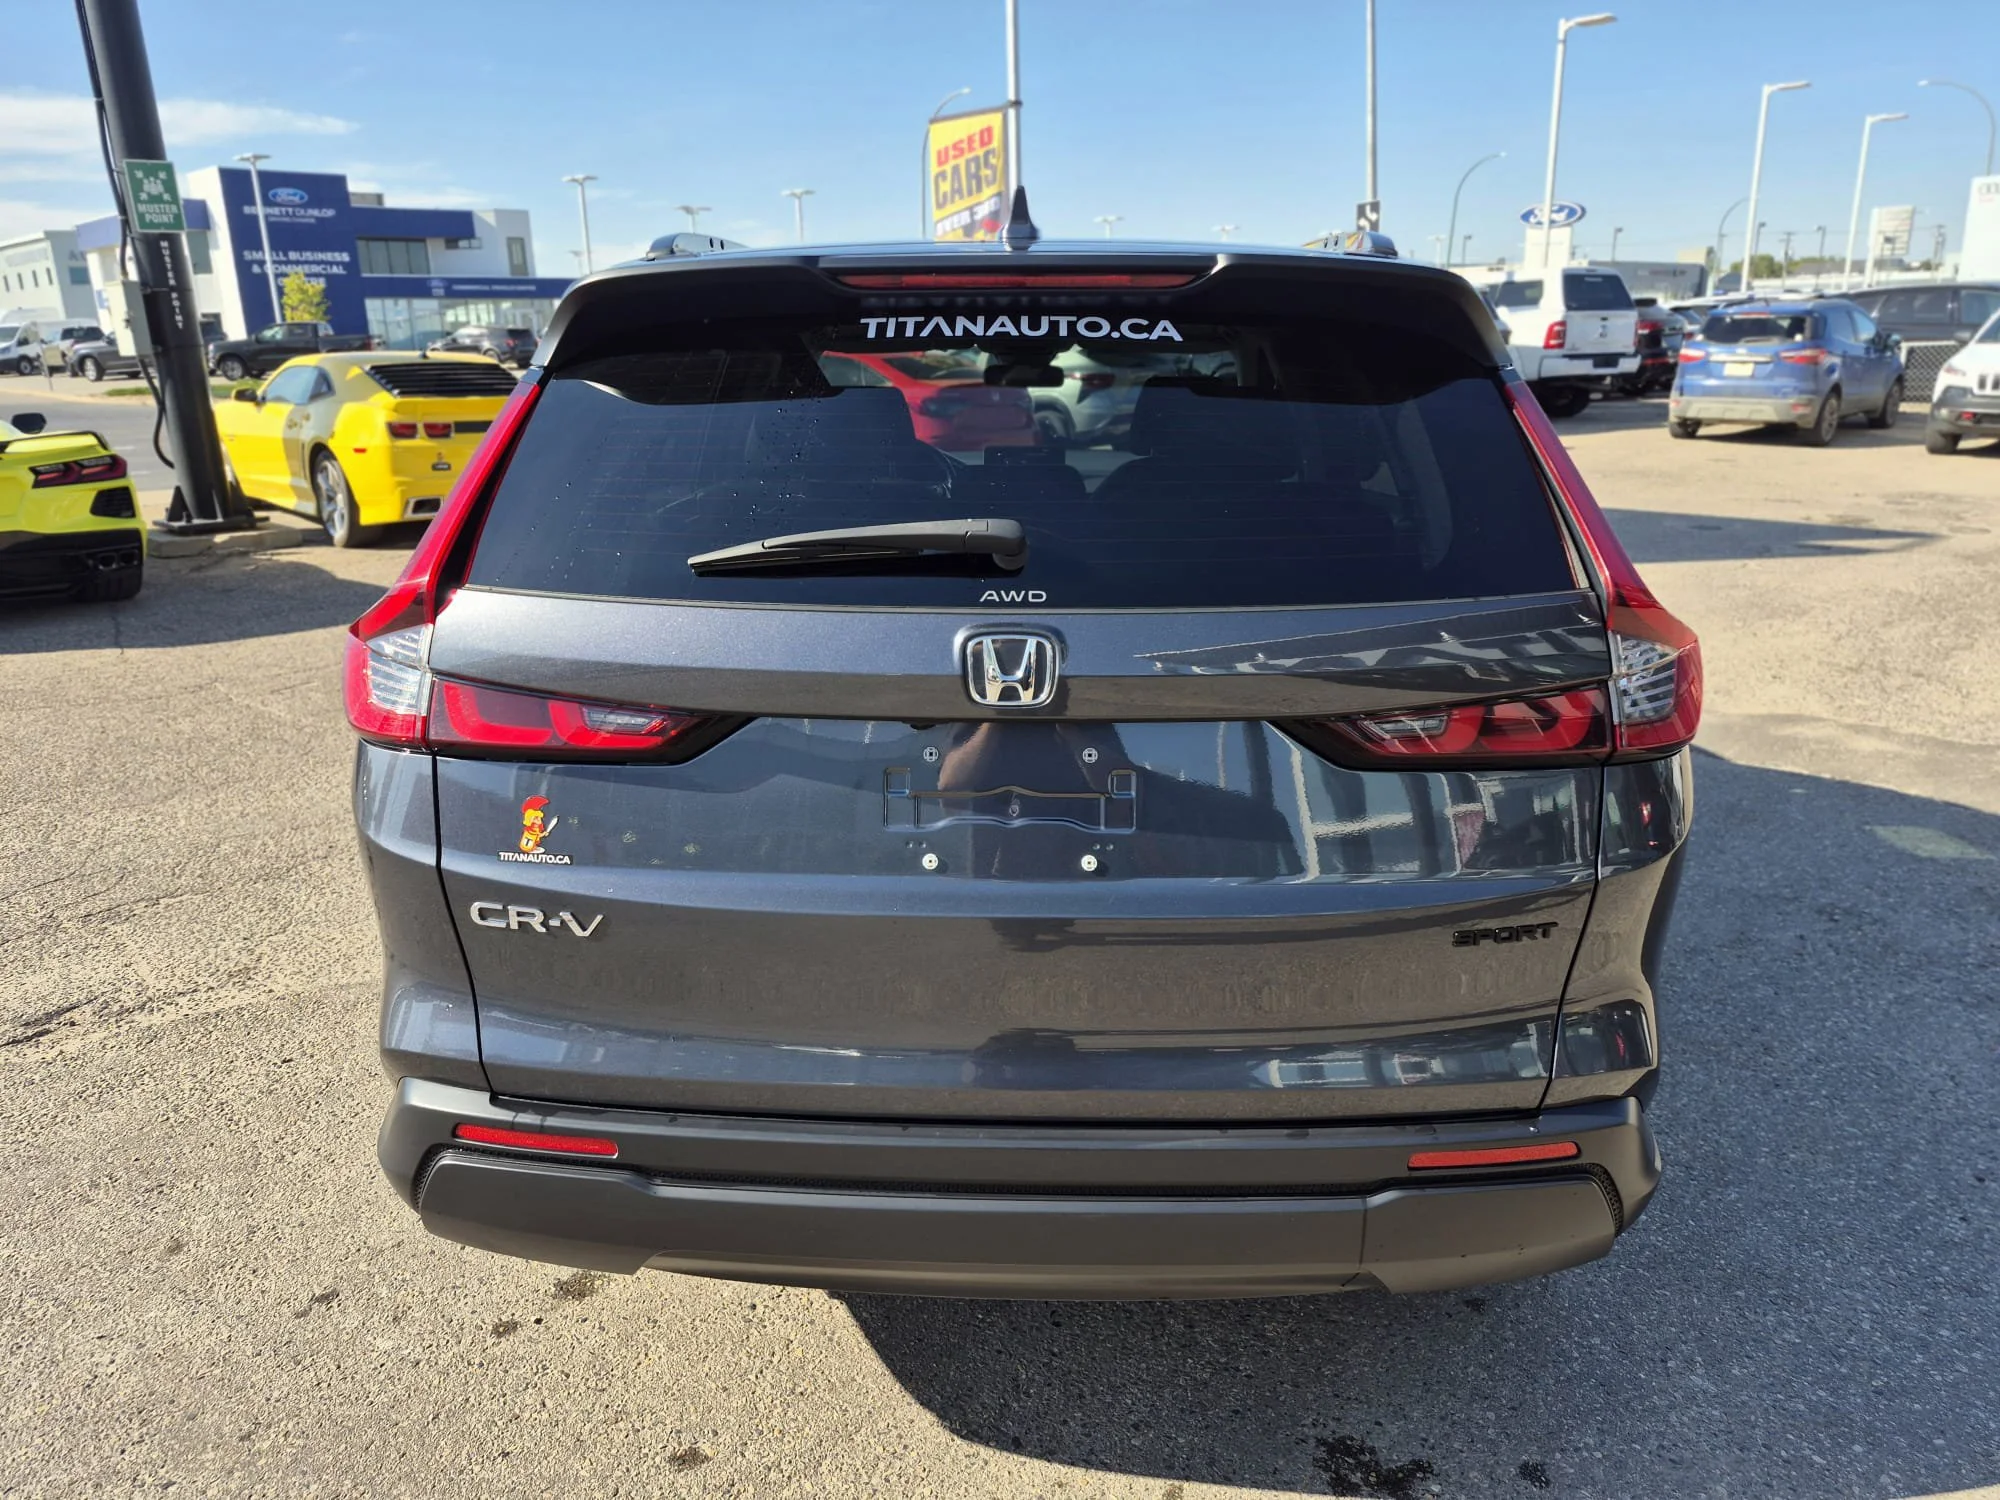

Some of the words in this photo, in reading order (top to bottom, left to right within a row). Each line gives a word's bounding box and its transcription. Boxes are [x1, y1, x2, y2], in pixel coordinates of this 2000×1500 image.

[937, 125, 994, 167] USED
[934, 148, 997, 210] CARS
[137, 203, 179, 214] MUSTER
[145, 213, 175, 224] POINT
[160, 240, 176, 286] MUSTER
[288, 251, 350, 262] BUSINESS
[860, 315, 1183, 341] TITANAUTO.CA
[979, 590, 1047, 602] AWD
[498, 851, 571, 865] TITANAUTO.CA
[470, 901, 604, 937] CR-V
[1451, 921, 1559, 947] SPORT
